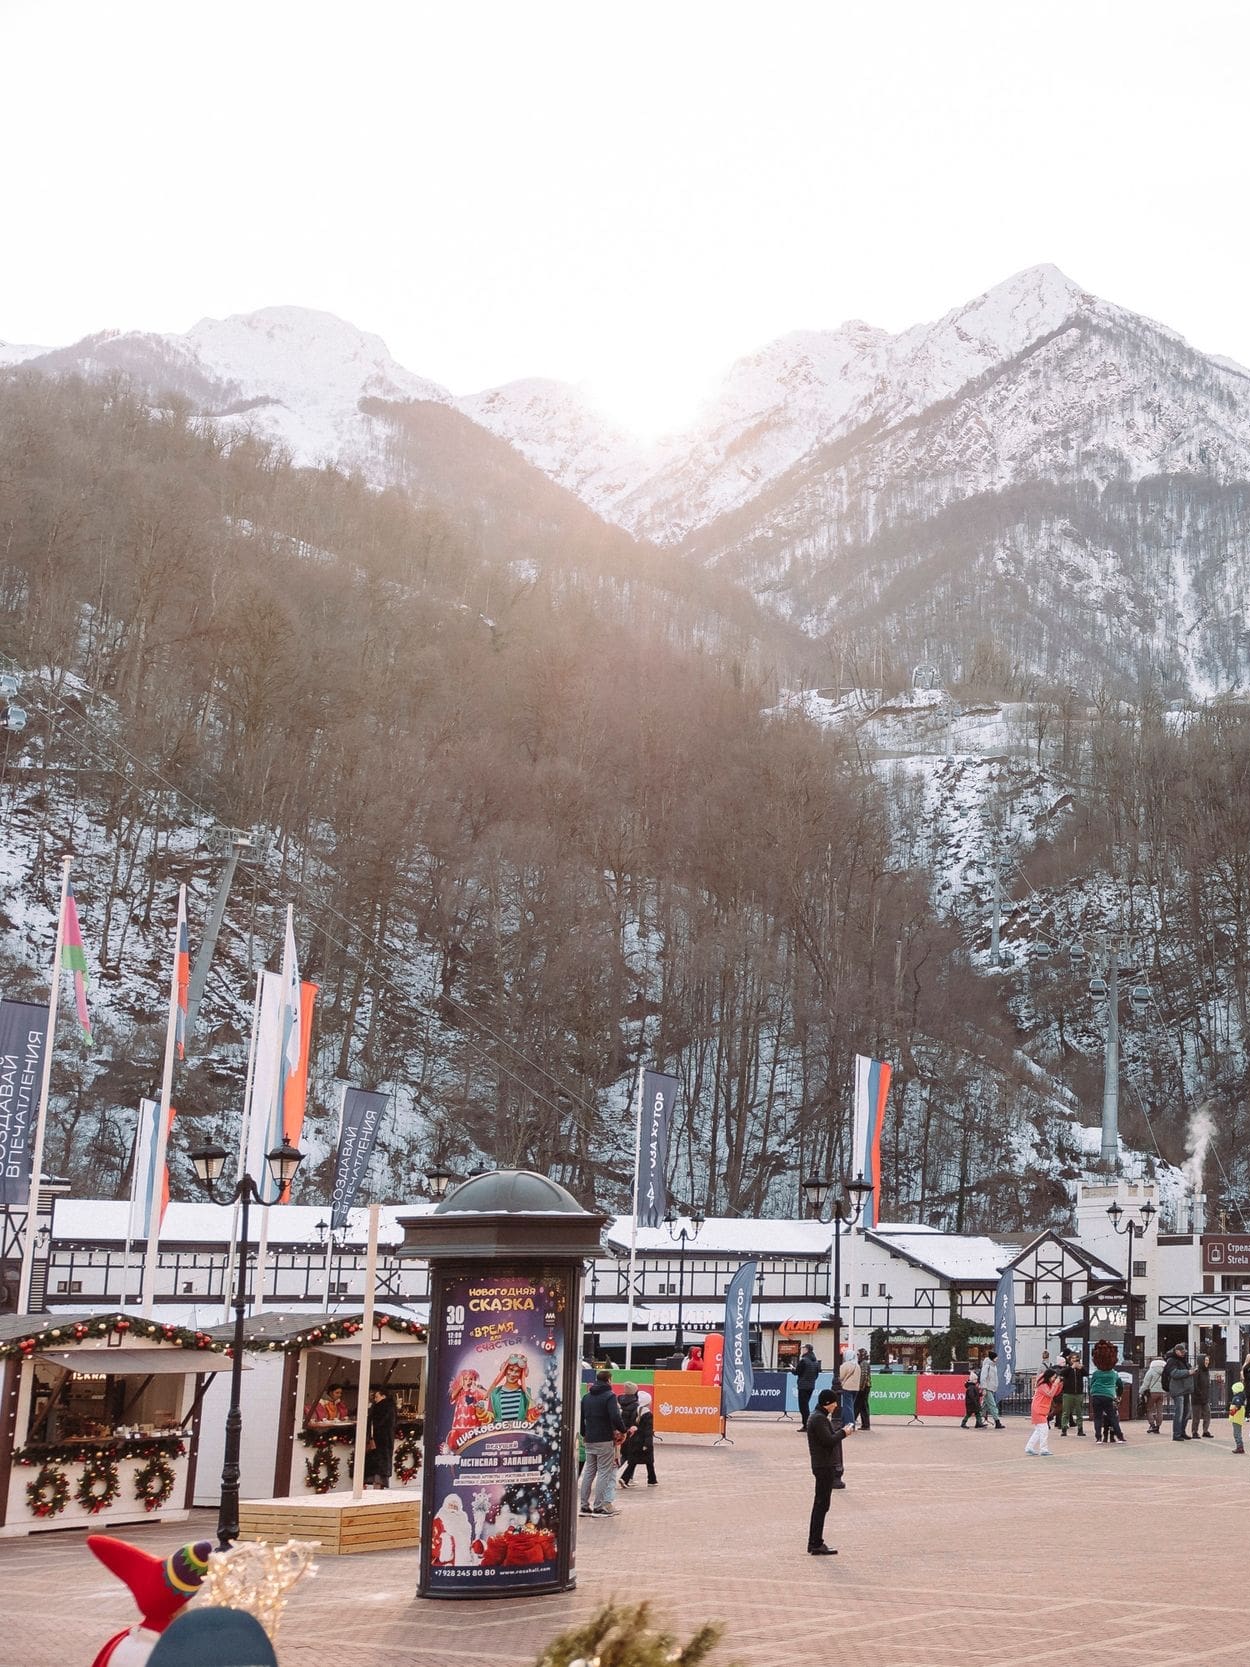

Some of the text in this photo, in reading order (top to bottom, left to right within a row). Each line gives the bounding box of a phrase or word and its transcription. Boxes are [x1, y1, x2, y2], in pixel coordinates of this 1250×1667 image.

[6, 1031, 44, 1178] ВПЕЧАТЛЕНИЯ
[0, 1055, 19, 1176] ЗДАВАЙ
[650, 1092, 664, 1138] ХУТОР
[331, 1126, 358, 1212] СОЗДАВАЙ
[340, 1110, 378, 1214] ВПЕЧАТЛЕНИЯ
[1227, 1255, 1249, 1264] Strela
[469, 1287, 536, 1297] НОВОГОДНЯЯ
[468, 1298, 535, 1312] СКАЗКА
[446, 1305, 465, 1325] 30
[734, 1288, 744, 1365] РОЗА ХУТОР
[786, 1320, 821, 1331] КАНТ
[870, 1391, 911, 1399] РОЗА ХУТОР
[674, 1406, 719, 1415] РОЗА ХУТОР
[512, 1420, 537, 1430] ШОУ
